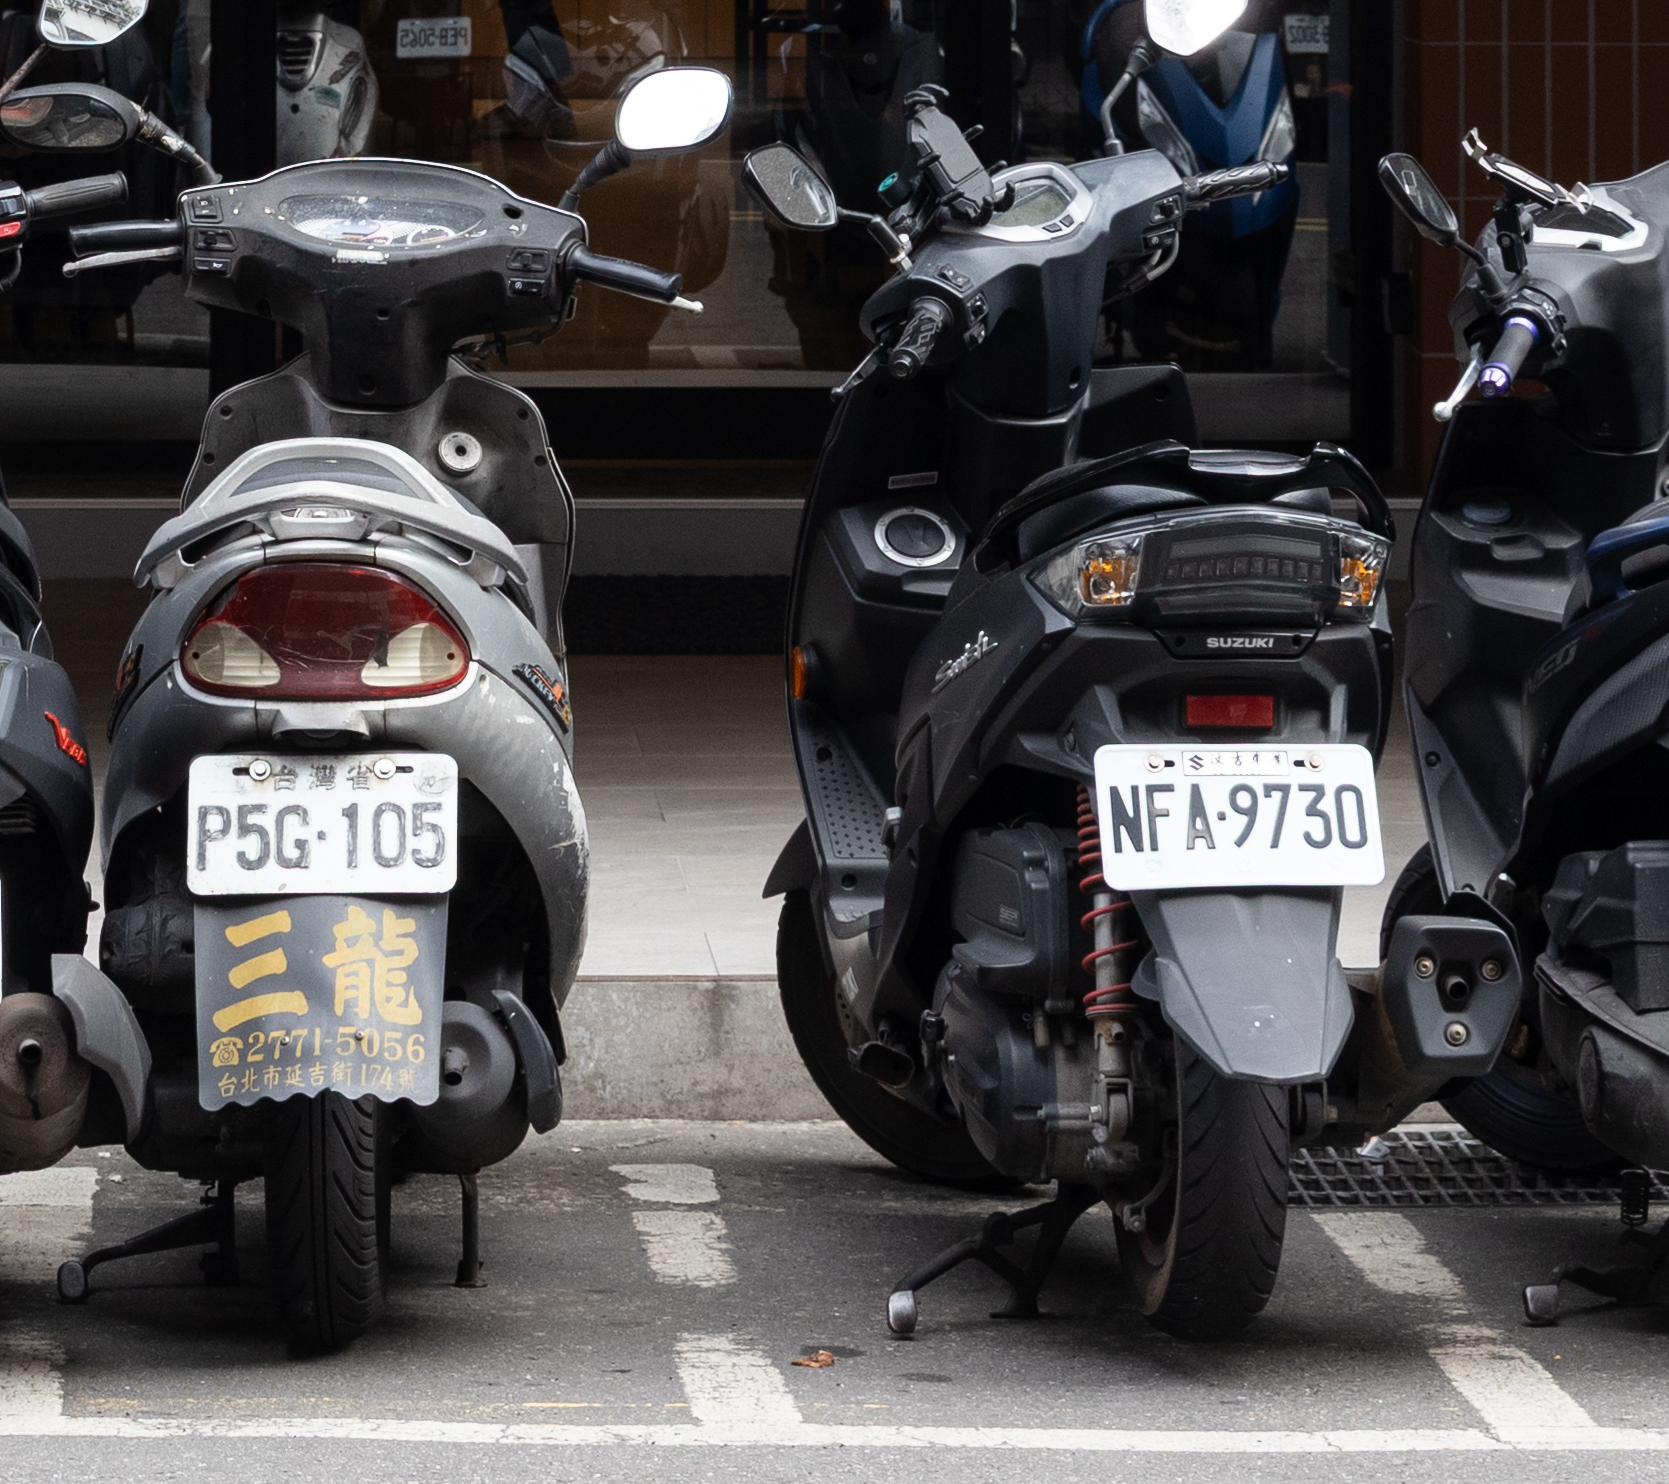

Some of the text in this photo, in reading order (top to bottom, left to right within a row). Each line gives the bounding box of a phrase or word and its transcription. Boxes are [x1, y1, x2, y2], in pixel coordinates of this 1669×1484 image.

[1206, 638, 1274, 649] SUZUKI
[273, 764, 372, 791] 台灣省
[212, 905, 423, 1032] 三龍
[247, 1027, 425, 1063] 2771-5056
